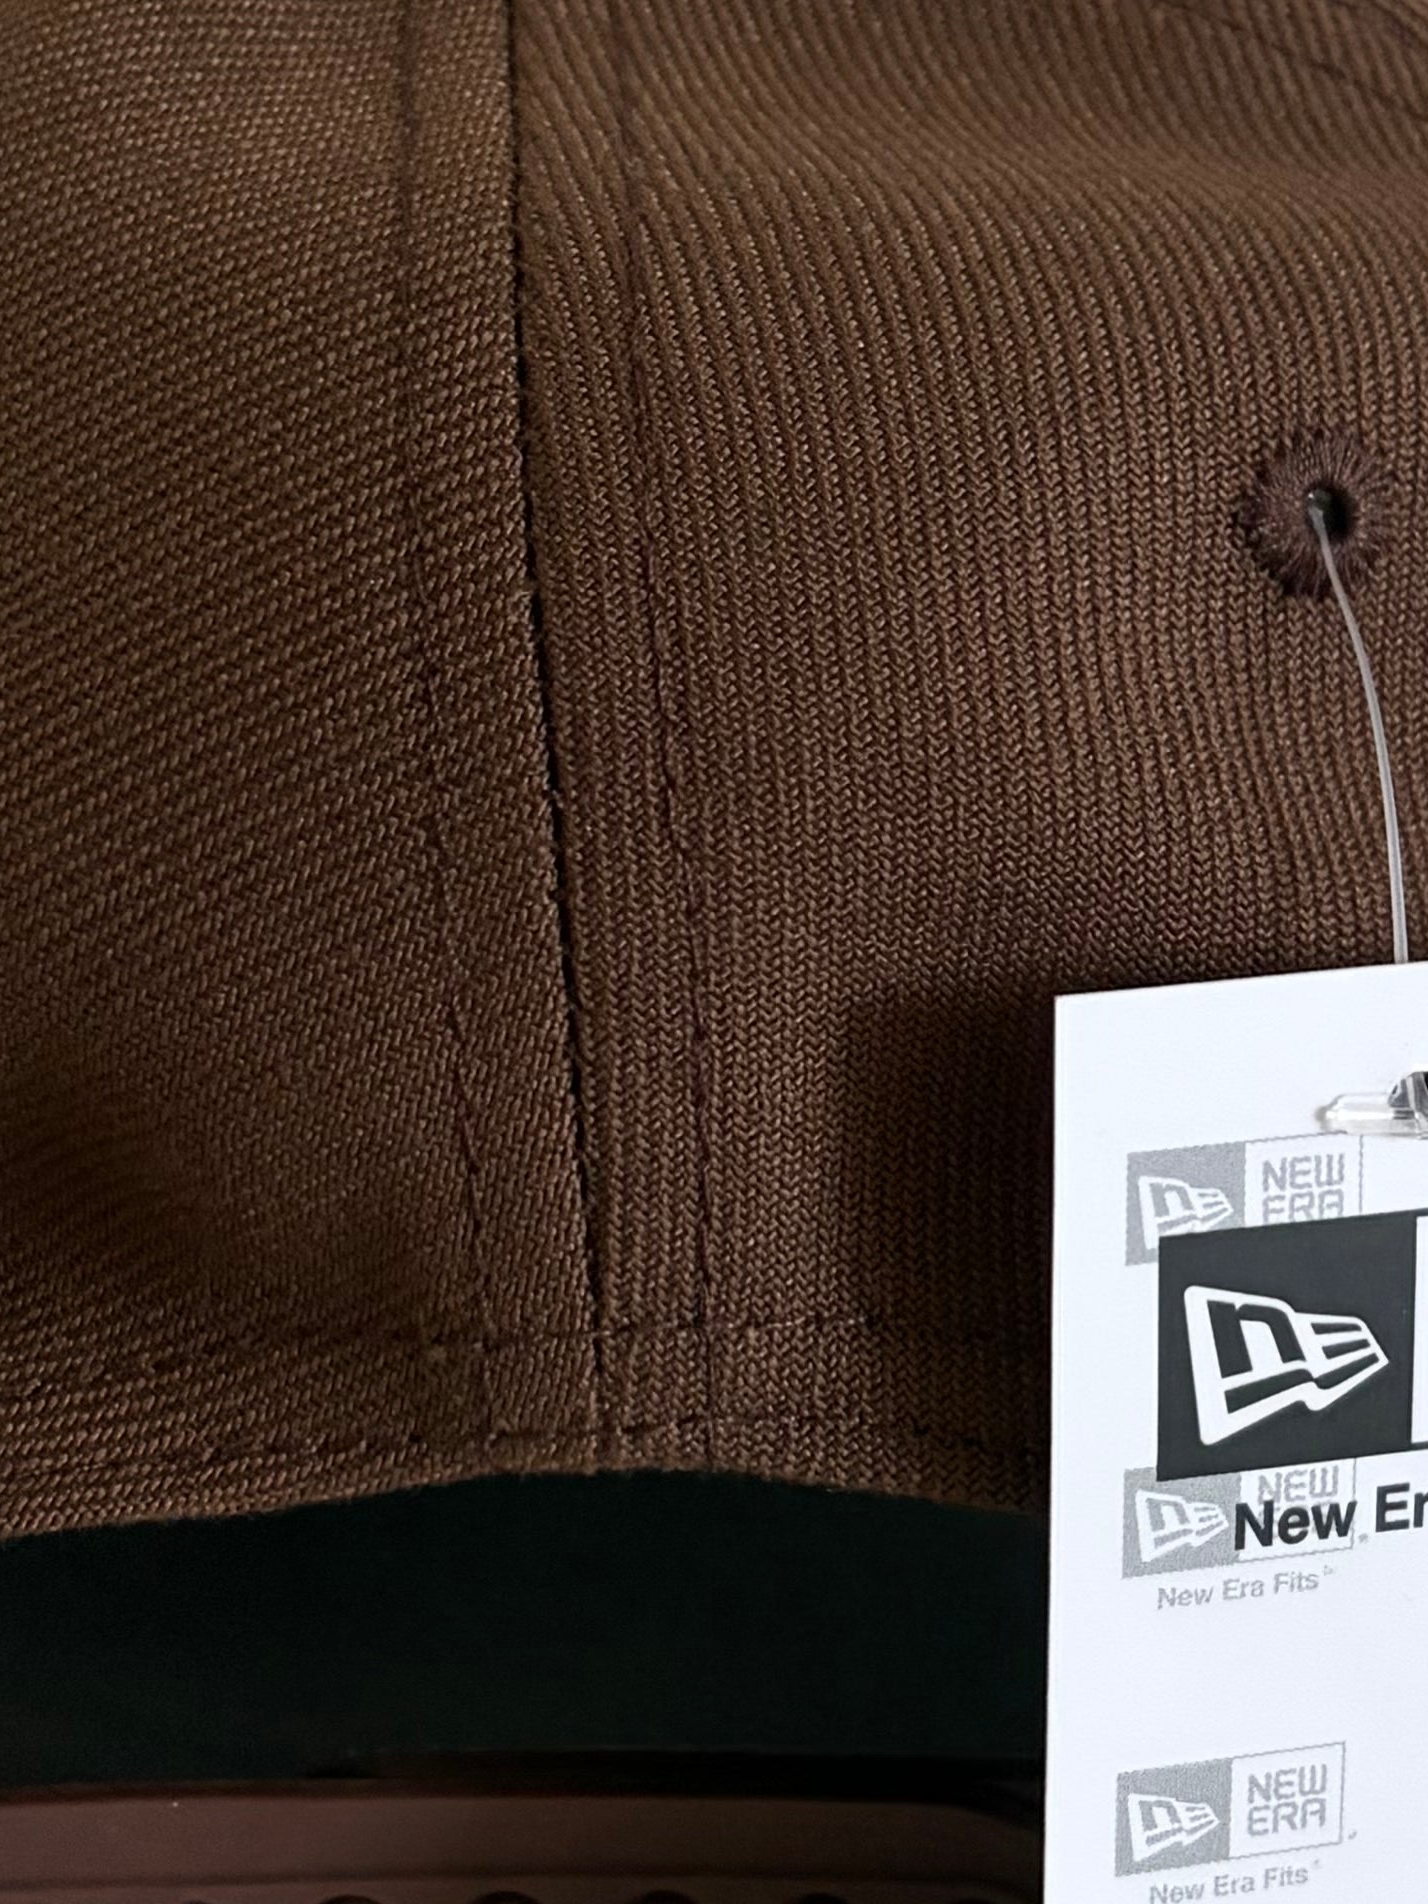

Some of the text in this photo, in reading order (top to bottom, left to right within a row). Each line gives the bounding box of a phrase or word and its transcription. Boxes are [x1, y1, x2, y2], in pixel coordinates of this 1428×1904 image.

[1262, 1153, 1345, 1192] NEW
[1262, 1188, 1344, 1225] ERA
[1257, 1464, 1340, 1506] NEW
[1233, 1499, 1358, 1552] New
[1157, 1585, 1214, 1611] New
[1222, 1577, 1265, 1601] Era
[1247, 1763, 1328, 1804] NEW
[1247, 1797, 1327, 1837] ERA
[1213, 1874, 1256, 1898] Era
